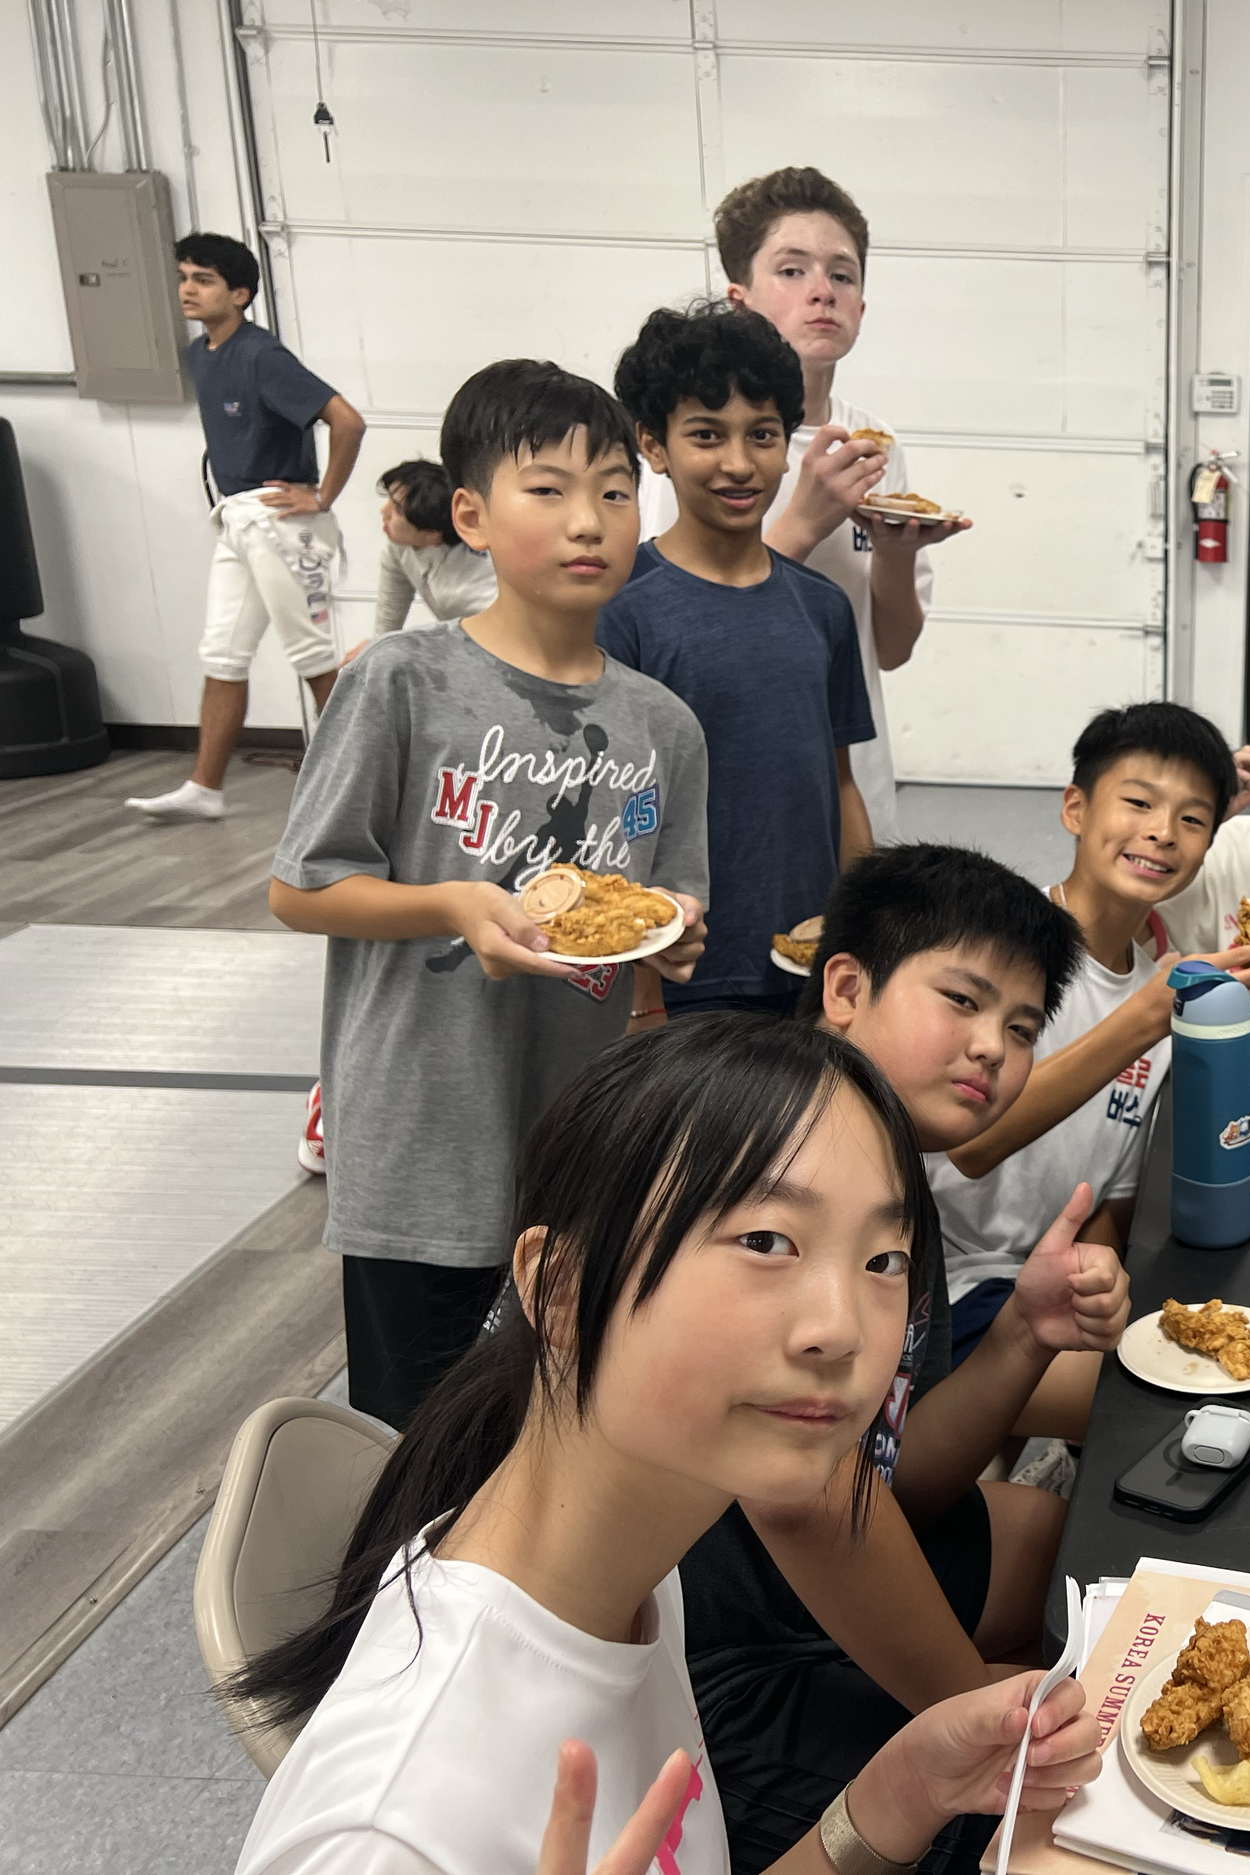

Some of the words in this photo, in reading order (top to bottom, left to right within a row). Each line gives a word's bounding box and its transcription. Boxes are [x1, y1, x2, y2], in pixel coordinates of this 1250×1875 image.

[458, 724, 657, 809] Inspired
[480, 809, 563, 890] by
[572, 816, 631, 871] the
[622, 786, 660, 842] 45
[1121, 1613, 1166, 1668] KOREA
[1095, 1673, 1136, 1747] SUMM
